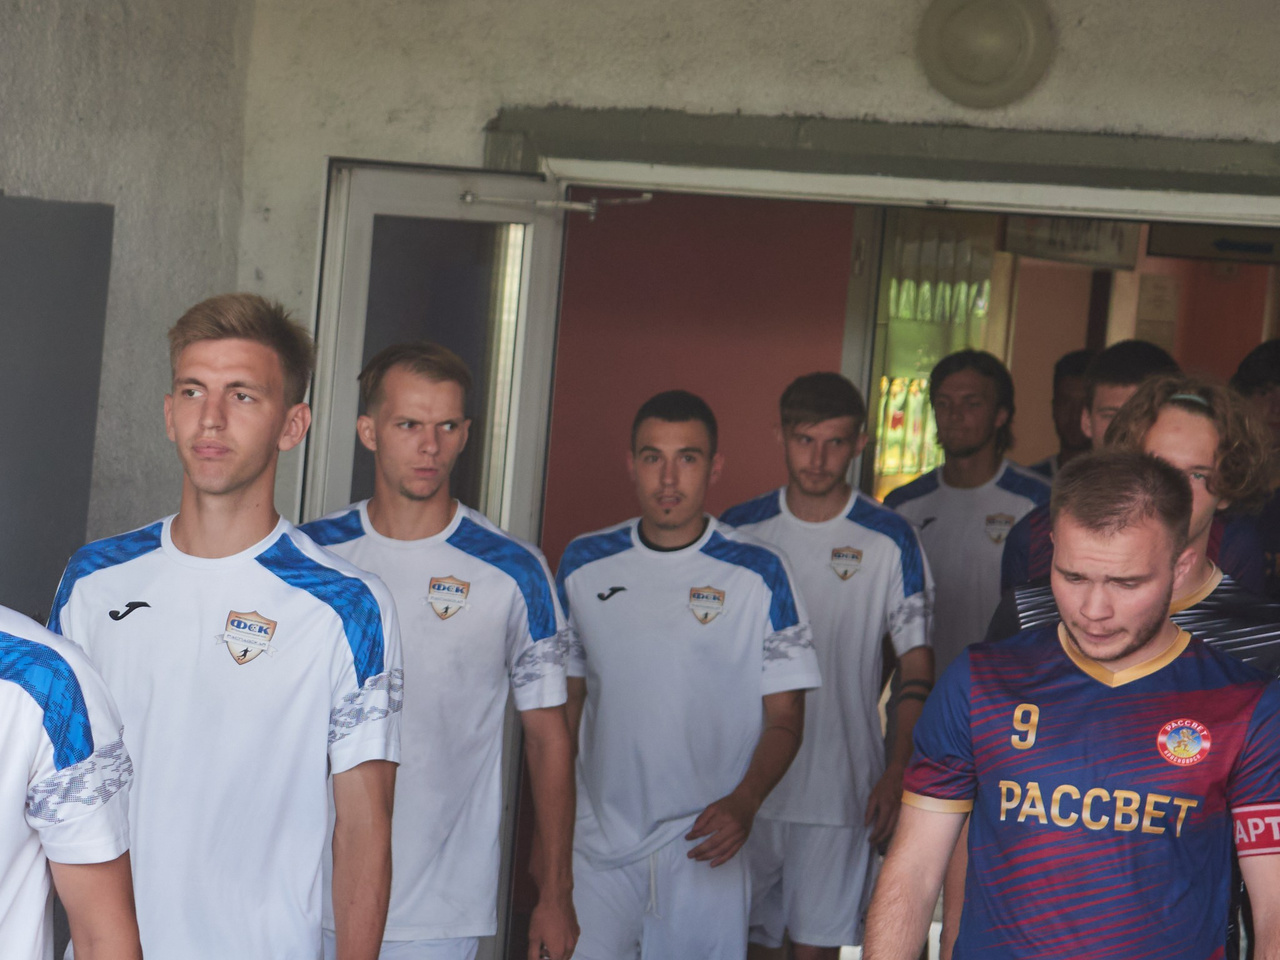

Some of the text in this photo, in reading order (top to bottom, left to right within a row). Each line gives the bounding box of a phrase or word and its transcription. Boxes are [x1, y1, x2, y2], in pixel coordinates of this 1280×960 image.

[1011, 703, 1040, 750] 9
[1165, 720, 1208, 736] РАССВЕТ
[998, 780, 1198, 838] РАССВЕТ
